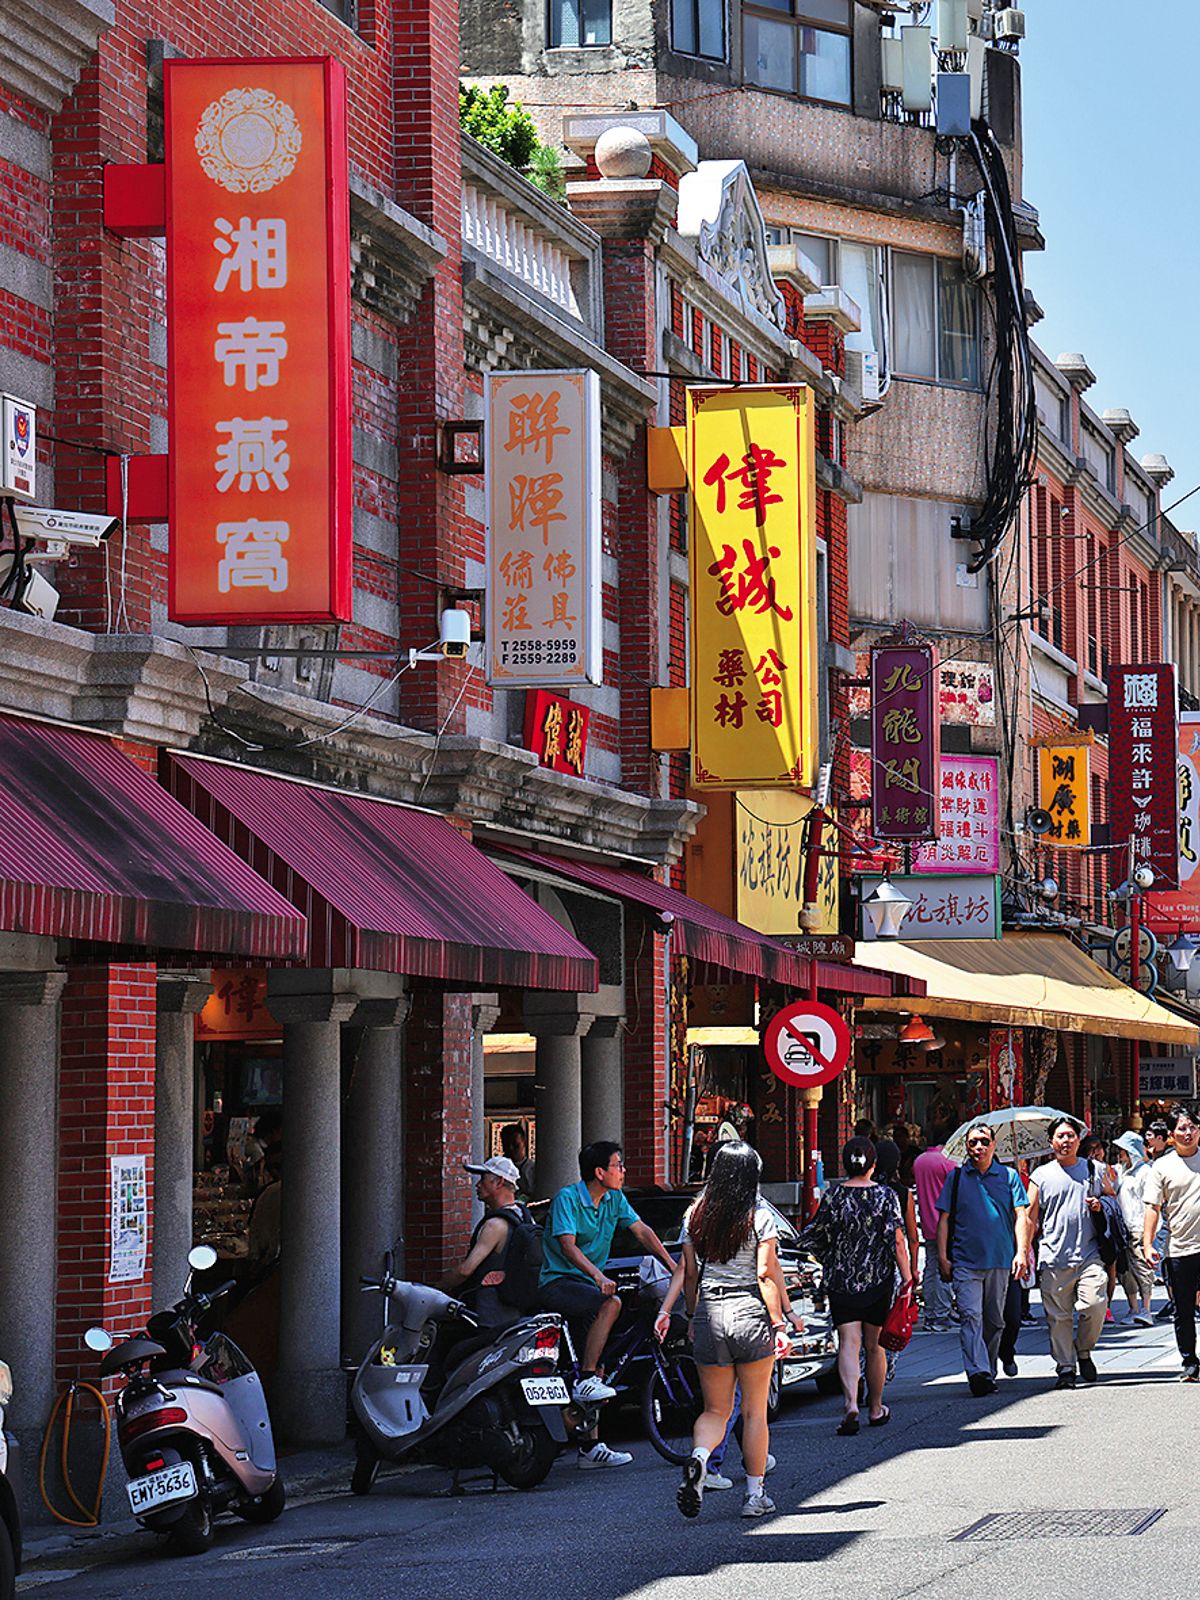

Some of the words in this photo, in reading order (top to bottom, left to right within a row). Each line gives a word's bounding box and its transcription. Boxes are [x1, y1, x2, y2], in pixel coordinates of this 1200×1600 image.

[212, 217, 290, 594] 湘帝燕窩
[702, 443, 794, 622] 偉誠
[542, 550, 577, 631] 佛具
[501, 641, 510, 652] T
[512, 640, 577, 652] 2558-5959
[502, 654, 510, 665] F
[512, 653, 577, 665] 2559-2289
[712, 649, 748, 730] 藥材
[753, 648, 787, 729] 公司
[1130, 717, 1153, 790] 福來許
[525, 1386, 569, 1400] 052-BGX
[131, 1472, 191, 1506] EMY-5636
